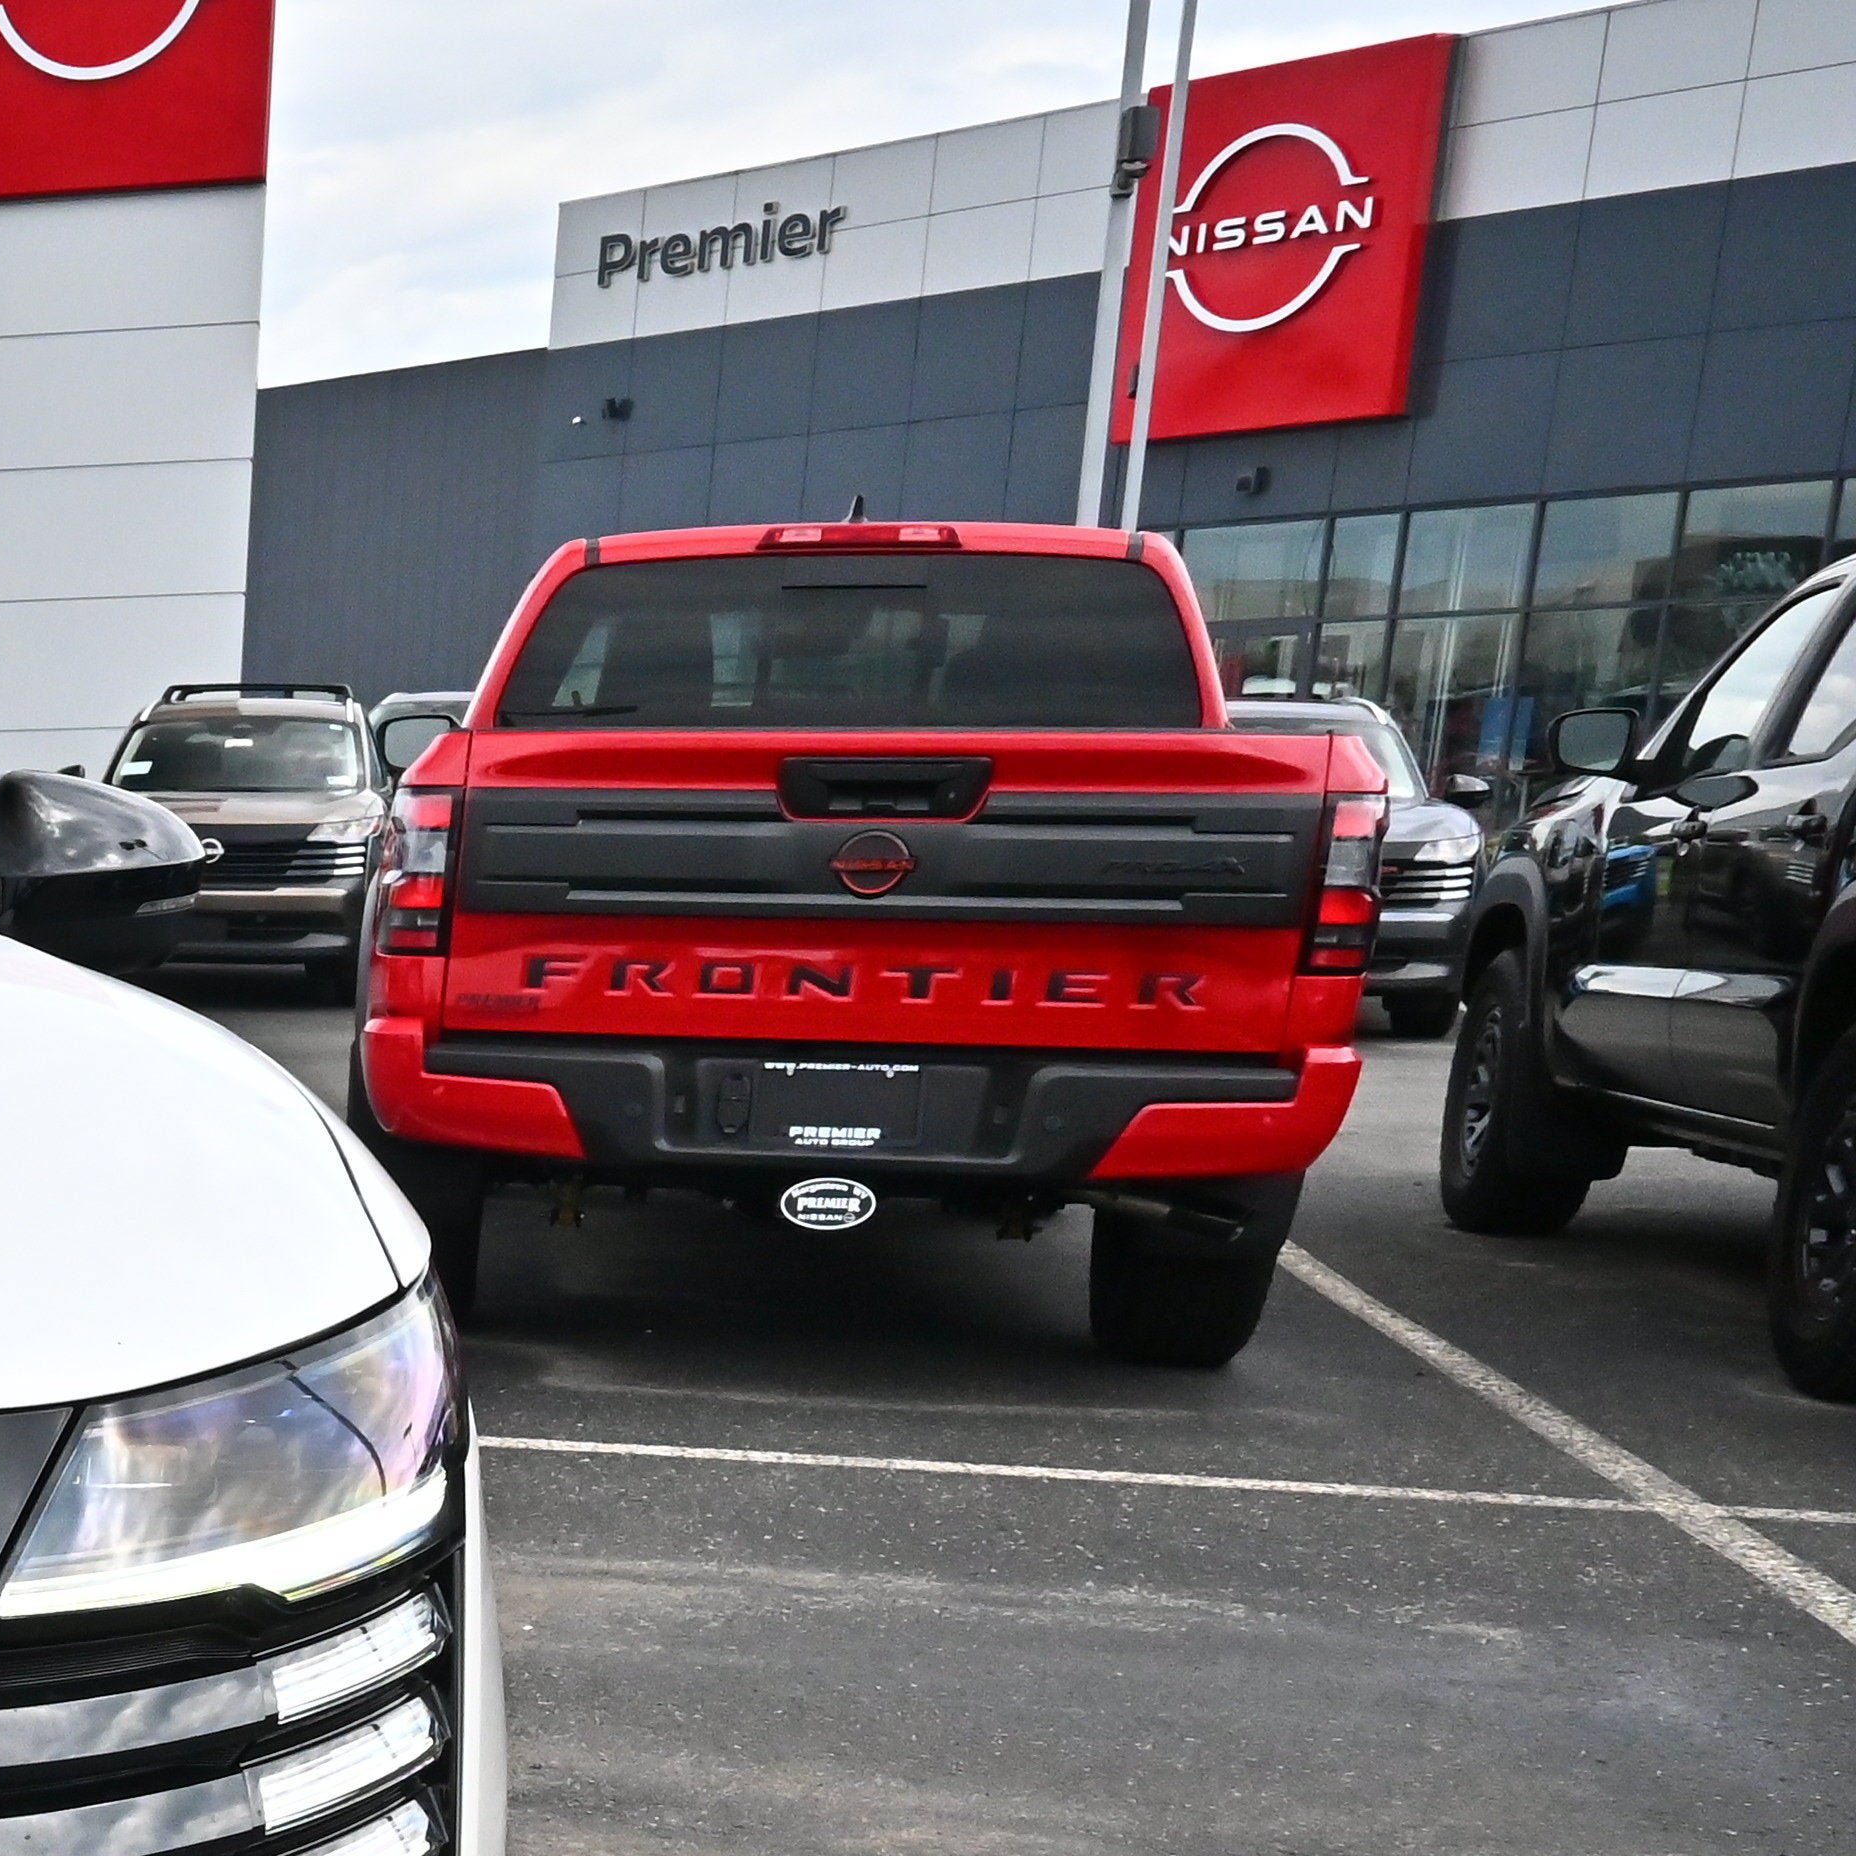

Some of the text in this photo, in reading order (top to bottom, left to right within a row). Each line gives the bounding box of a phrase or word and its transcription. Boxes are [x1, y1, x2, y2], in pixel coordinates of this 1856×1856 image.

[597, 201, 848, 288] Premier
[1169, 196, 1374, 257] NISSAN
[522, 953, 1206, 1012] FRONTIER
[789, 1126, 881, 1140] PREMIER
[794, 1138, 875, 1147] AUTO GROUP
[797, 1196, 861, 1213] PREMIER
